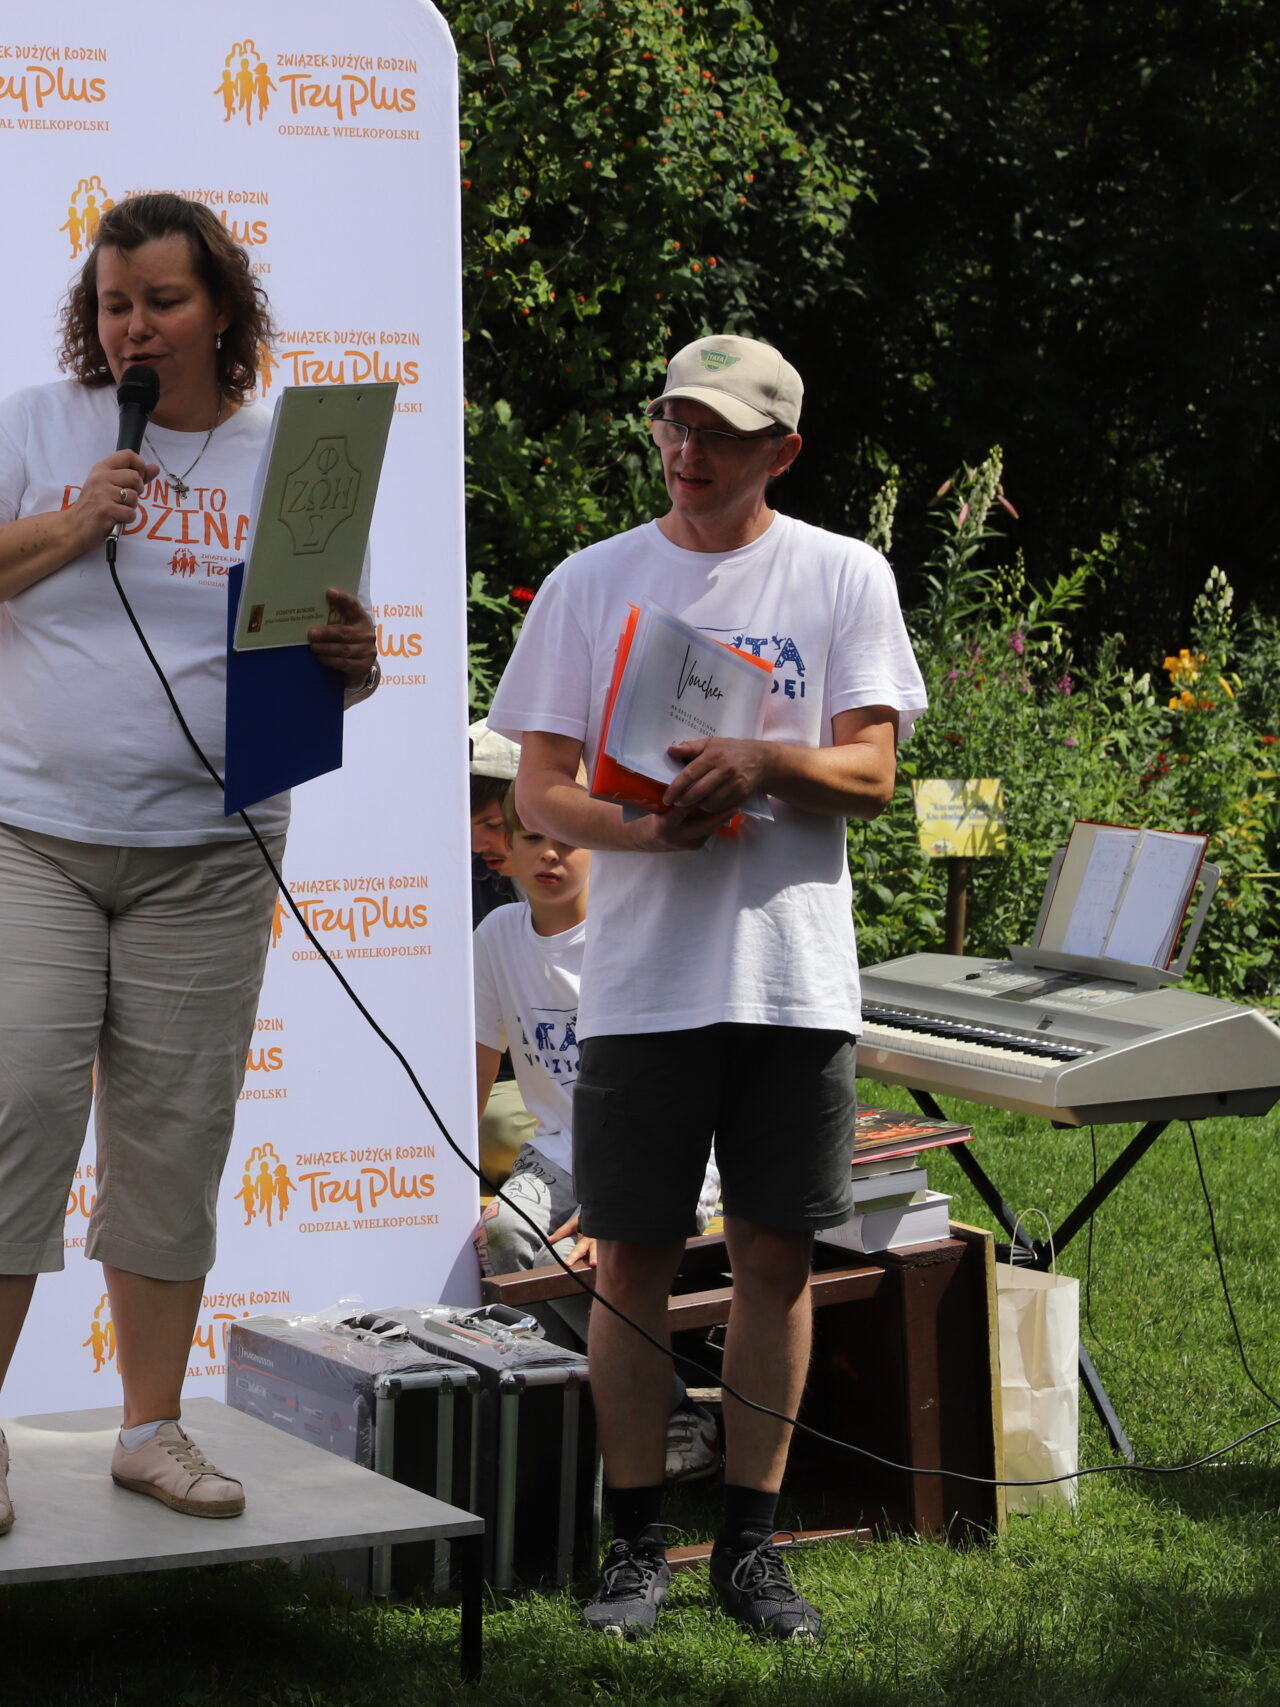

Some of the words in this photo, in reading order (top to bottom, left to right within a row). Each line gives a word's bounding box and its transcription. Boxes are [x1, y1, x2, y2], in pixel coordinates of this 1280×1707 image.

[14, 46, 61, 62] DUŻYCH
[64, 47, 108, 61] RODZIN
[276, 54, 329, 68] ZWIĄZEK
[329, 54, 374, 71] DUŻYCH
[376, 57, 418, 72] RODZIN
[17, 120, 110, 131] WIELKOPOLSKI
[279, 125, 329, 136] ODDZIAŁ
[333, 127, 419, 140] WIELKOPOLSKI
[228, 190, 269, 205] RODZIN
[277, 331, 332, 344] ZWIĄZEK
[332, 331, 377, 346] DUŻYCH
[379, 331, 421, 345] RODZIN
[194, 488, 227, 512] TO
[384, 604, 424, 617] RODZIN
[288, 880, 341, 894] ZWIĄZEK
[341, 877, 386, 892] DUŻYCH
[388, 876, 429, 889] RODZIN
[345, 945, 432, 958] WIELKOPOLSKI
[295, 1151, 348, 1166] ZWIĄZEK
[348, 1148, 394, 1163] DUŻYCH
[395, 1144, 436, 1160] RODZIN
[300, 1222, 350, 1233] ODDZIAŁ
[352, 1214, 439, 1229] WIELKOPOLSKI
[251, 1290, 291, 1304] RODZIN
